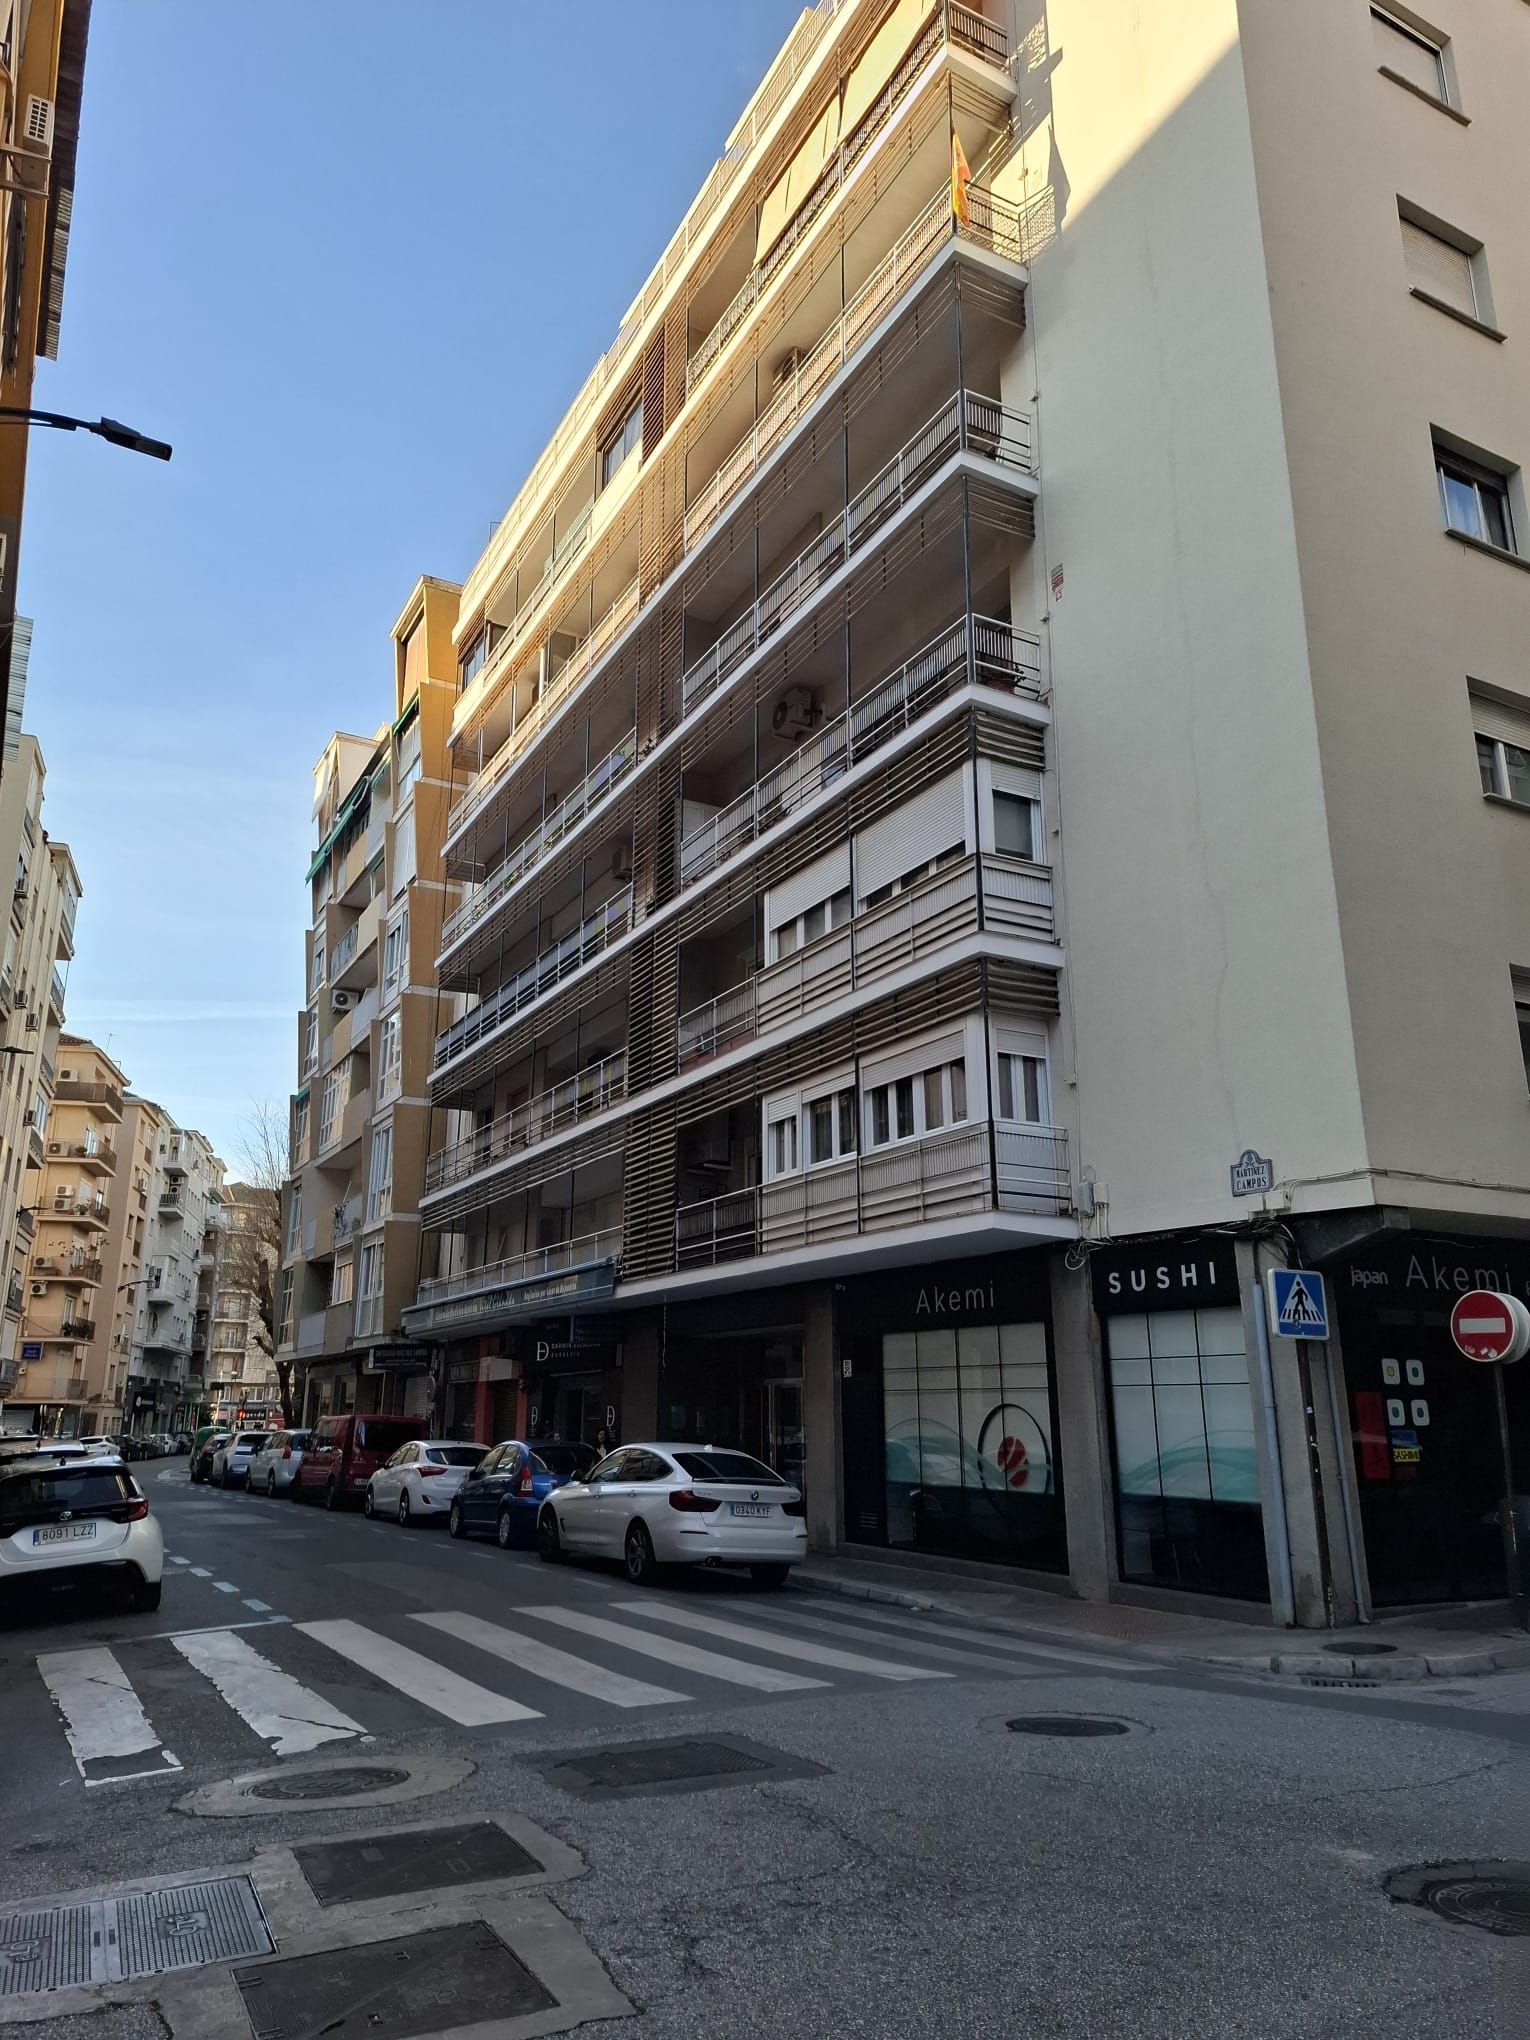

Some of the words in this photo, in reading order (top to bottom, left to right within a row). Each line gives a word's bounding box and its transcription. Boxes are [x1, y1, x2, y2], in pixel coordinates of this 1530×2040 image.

[1236, 1176, 1267, 1191] CAMPOS
[1108, 1261, 1218, 1294] SUSHI
[1349, 1265, 1389, 1289] japan
[1405, 1255, 1513, 1294] Akemi
[915, 1280, 996, 1314] Akemi
[735, 1504, 755, 1515] 0340
[42, 1527, 69, 1541] 8091
[73, 1525, 94, 1537] LZZ
